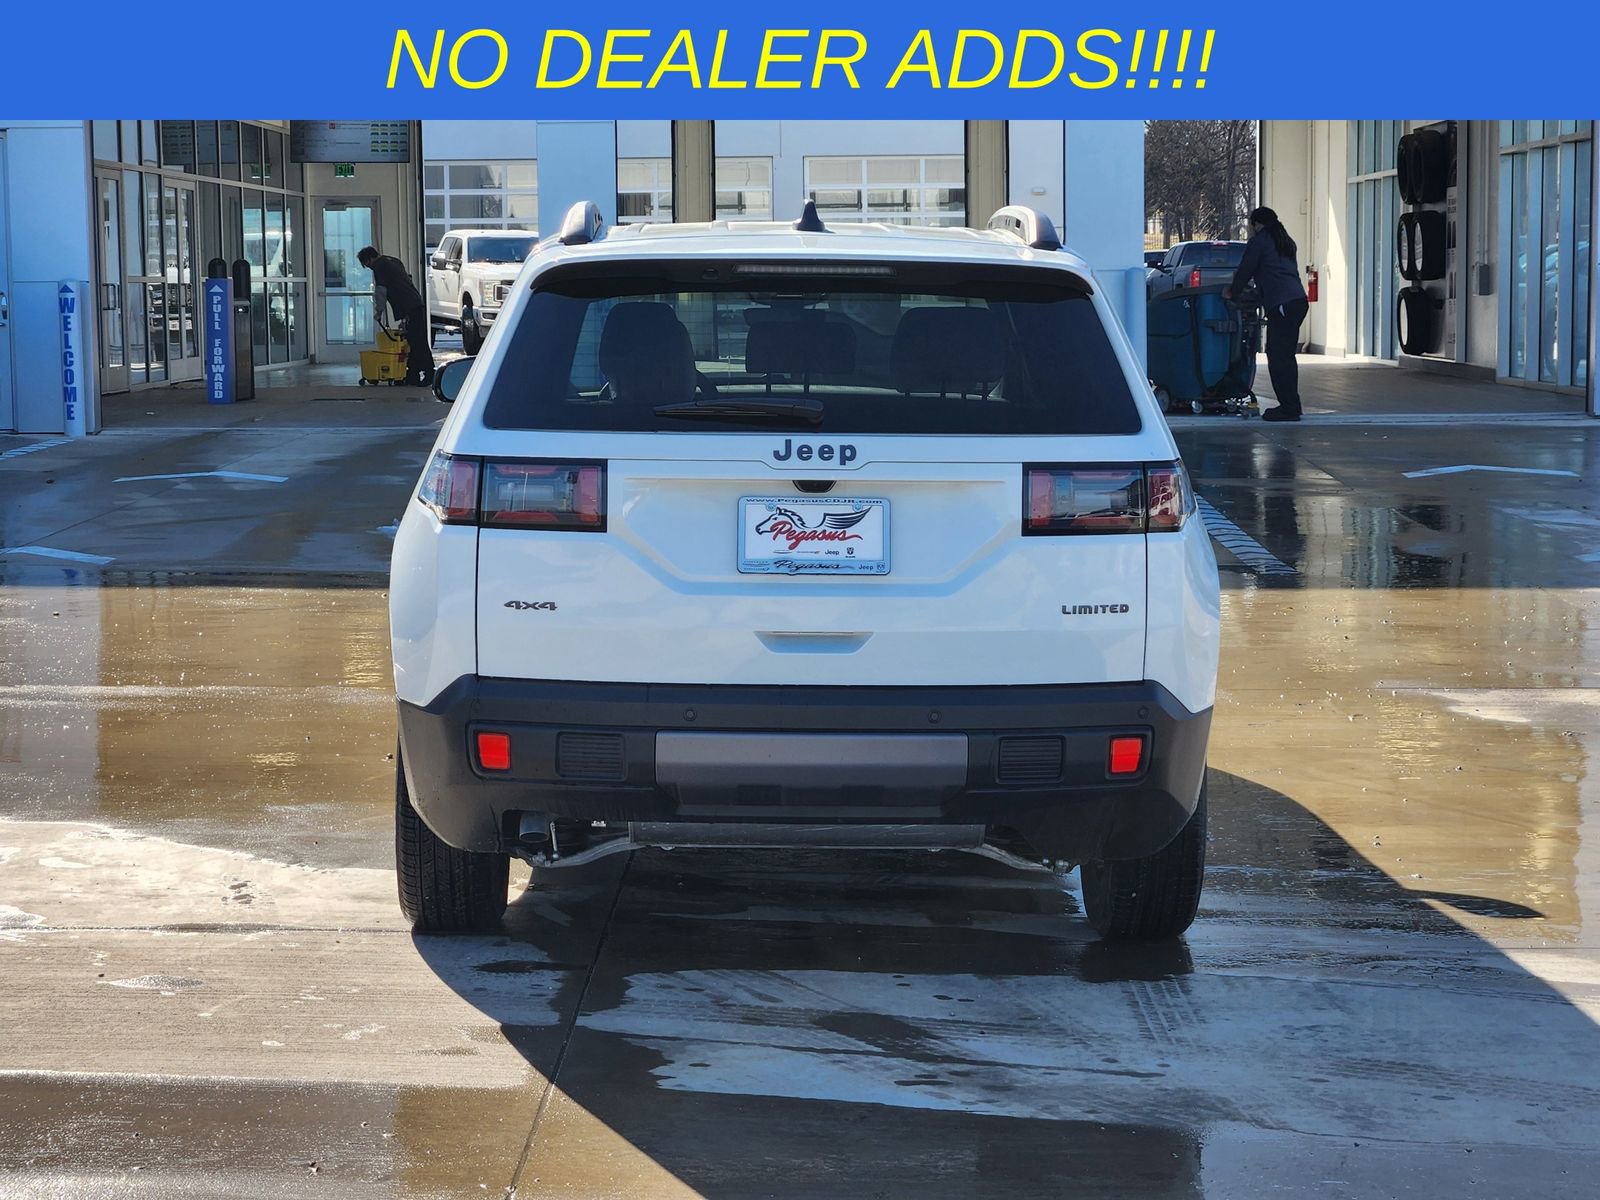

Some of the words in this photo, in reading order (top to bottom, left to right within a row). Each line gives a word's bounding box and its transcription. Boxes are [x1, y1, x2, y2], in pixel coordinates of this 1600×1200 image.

[212, 295, 222, 330] PULL
[59, 297, 77, 420] WELCOME
[211, 338, 225, 399] FORWARD
[773, 438, 857, 466] Jeep
[769, 520, 864, 551] Pegasus
[773, 559, 855, 572] Pegasus
[858, 563, 874, 571] Jeep
[1061, 603, 1130, 615] LIMITED
